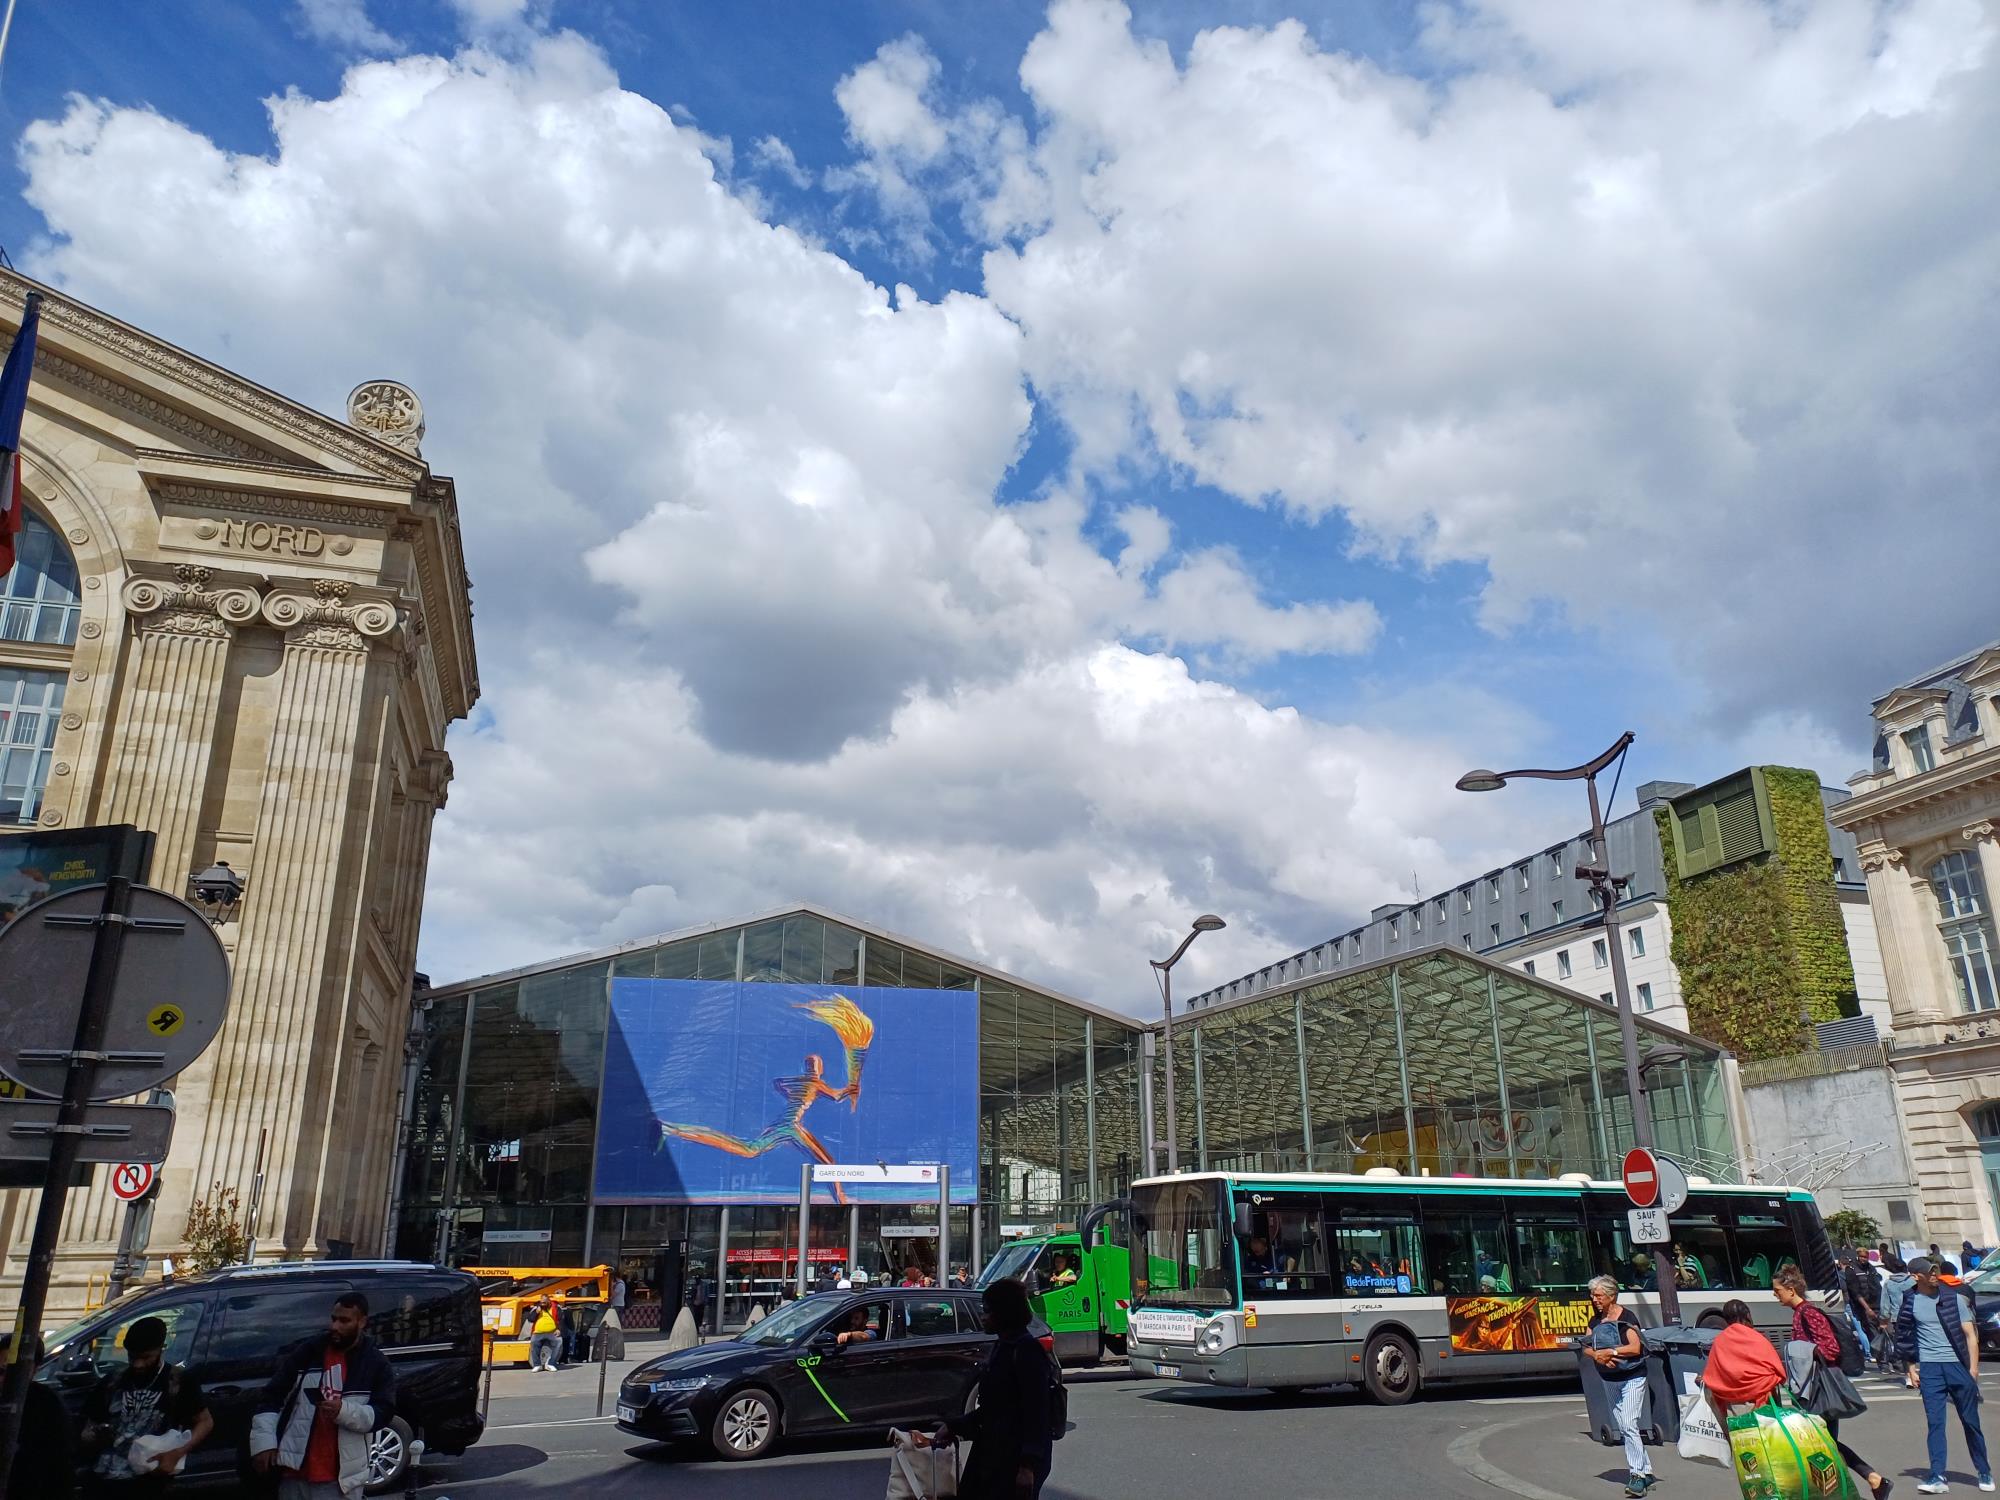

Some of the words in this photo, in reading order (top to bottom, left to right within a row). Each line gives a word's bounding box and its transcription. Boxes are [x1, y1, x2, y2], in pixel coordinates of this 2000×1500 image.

[220, 517, 325, 557] NORD
[1636, 1210, 1656, 1220] SAUF
[1058, 1310, 1082, 1318] PARIS
[1539, 1305, 1595, 1328] FURIOSA
[808, 1355, 822, 1366] G7
[1699, 1420, 1706, 1428] CE
[1707, 1421, 1717, 1429] SAC
[1701, 1428, 1714, 1437] FAIT
